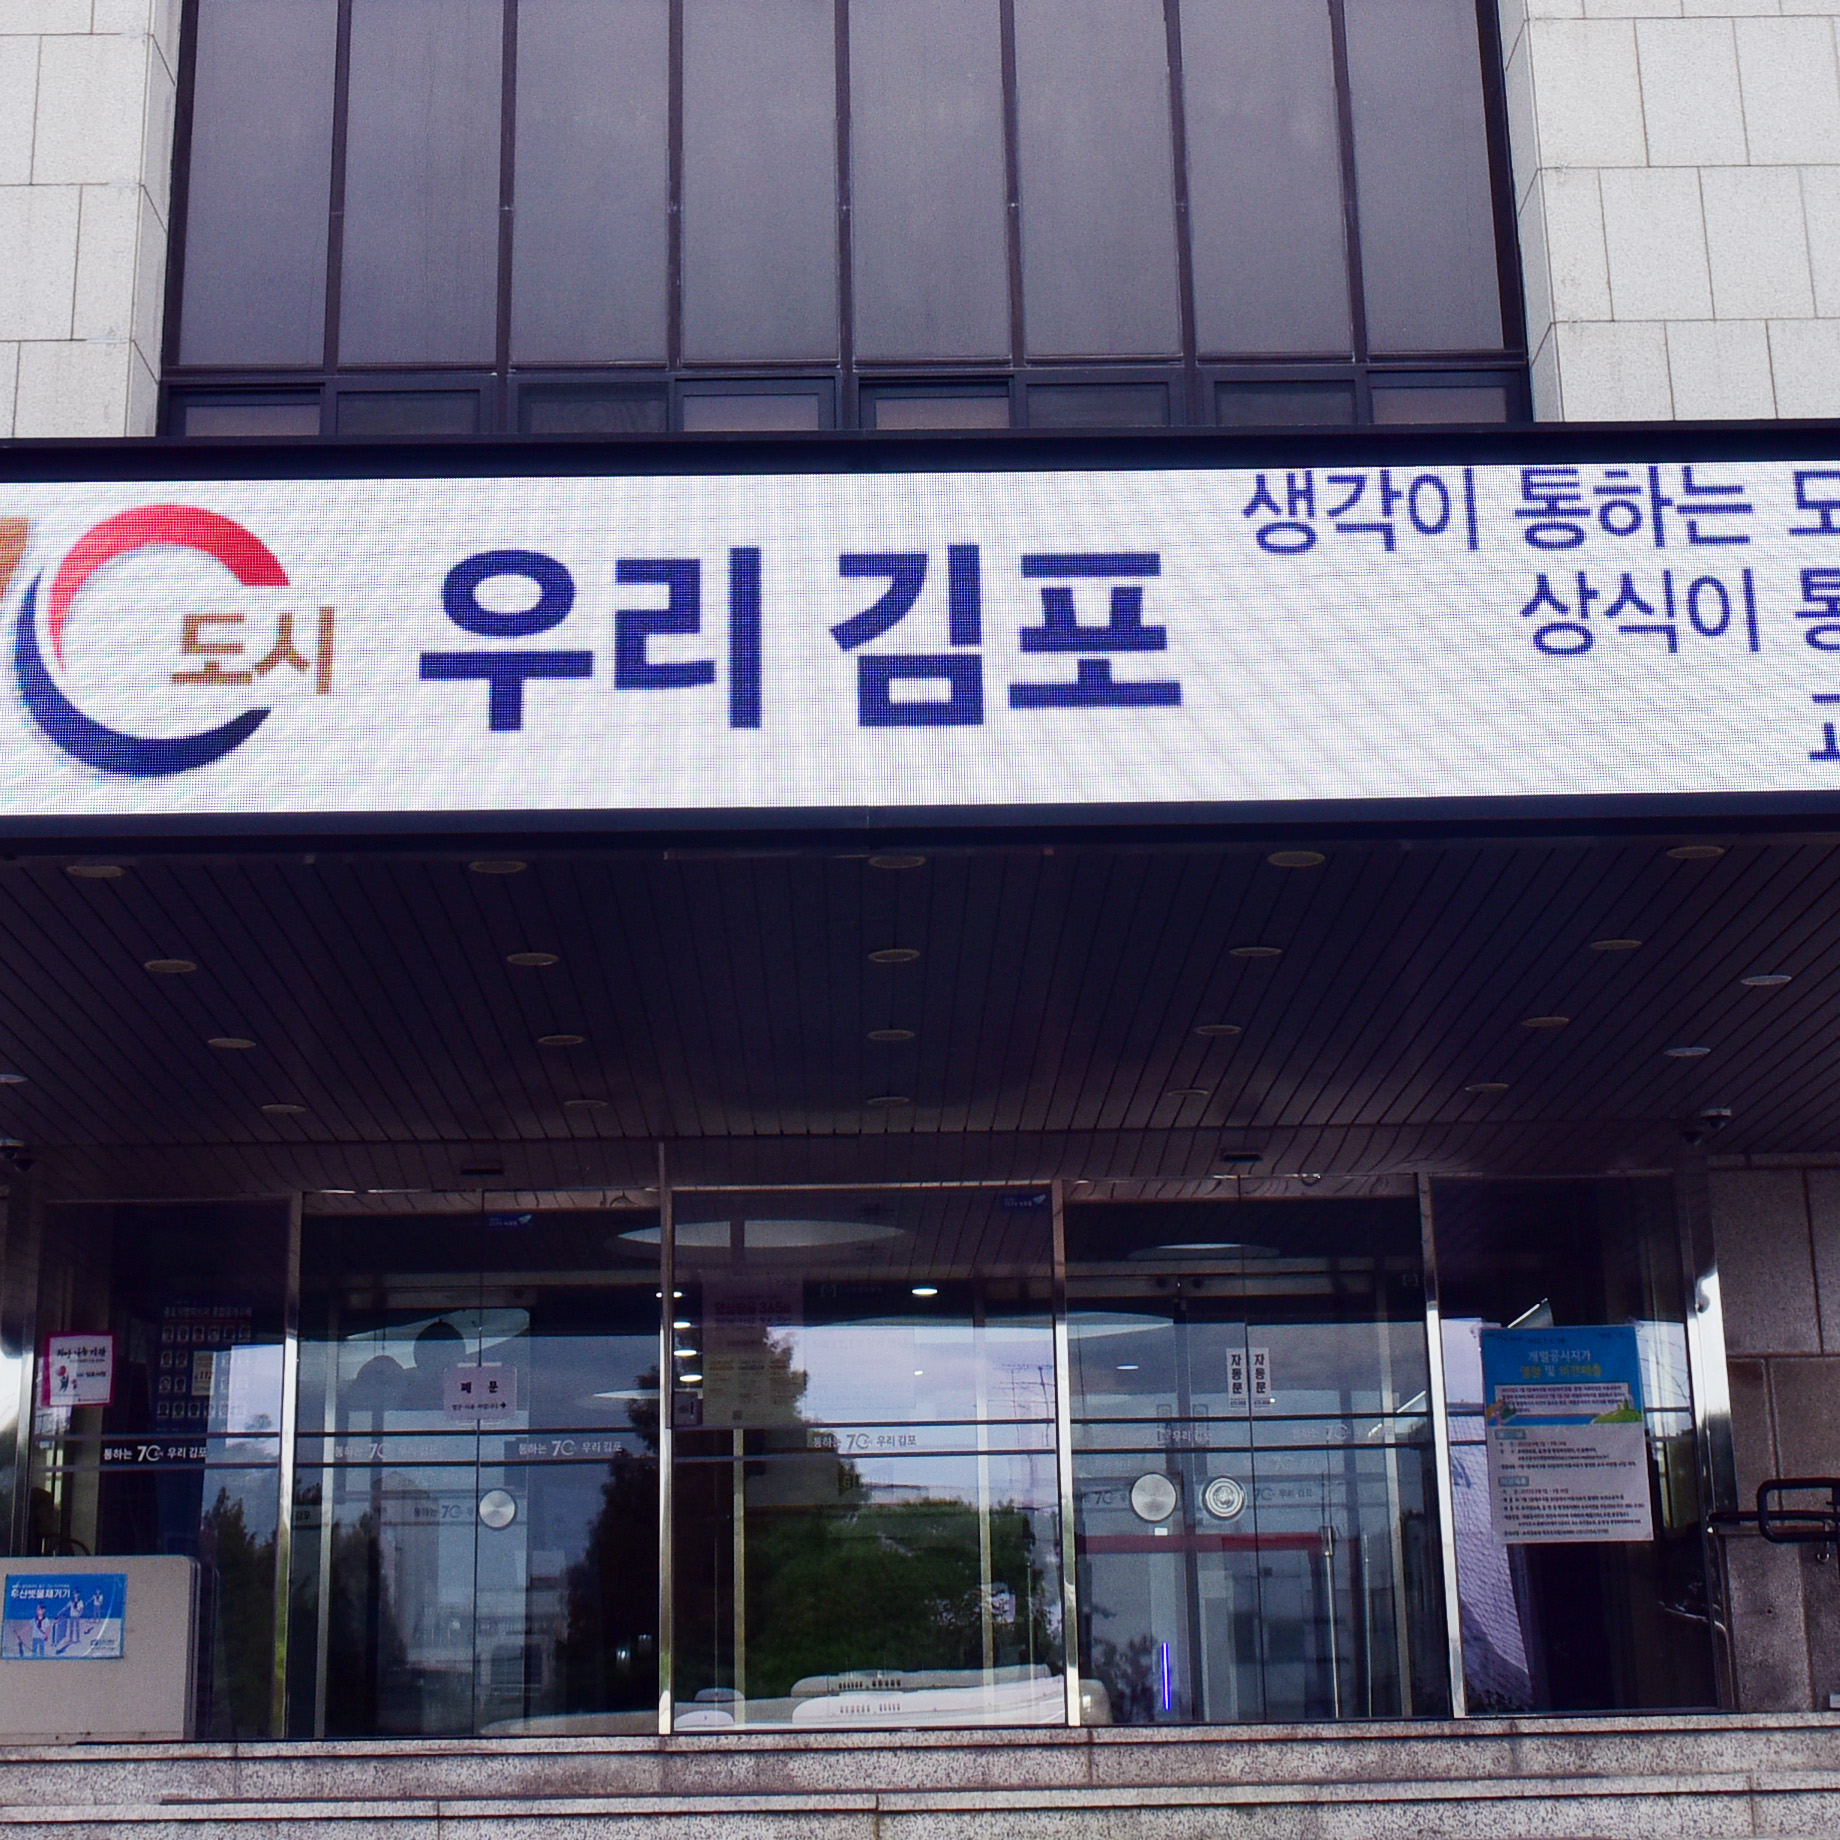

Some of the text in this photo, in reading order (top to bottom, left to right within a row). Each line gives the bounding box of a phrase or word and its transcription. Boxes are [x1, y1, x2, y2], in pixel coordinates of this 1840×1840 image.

[1241, 466, 1478, 556] 생각이
[1512, 464, 1755, 549] 통하는
[1521, 569, 1760, 655] 상식이
[170, 604, 336, 696] 도시
[418, 546, 762, 732] 우리
[828, 542, 1182, 728] 김포
[1231, 1354, 1243, 1394] 자동문
[1254, 1353, 1266, 1394] 자동문
[167, 1447, 186, 1458] 우리
[876, 1435, 895, 1447] 우리
[898, 1435, 917, 1446] 김포
